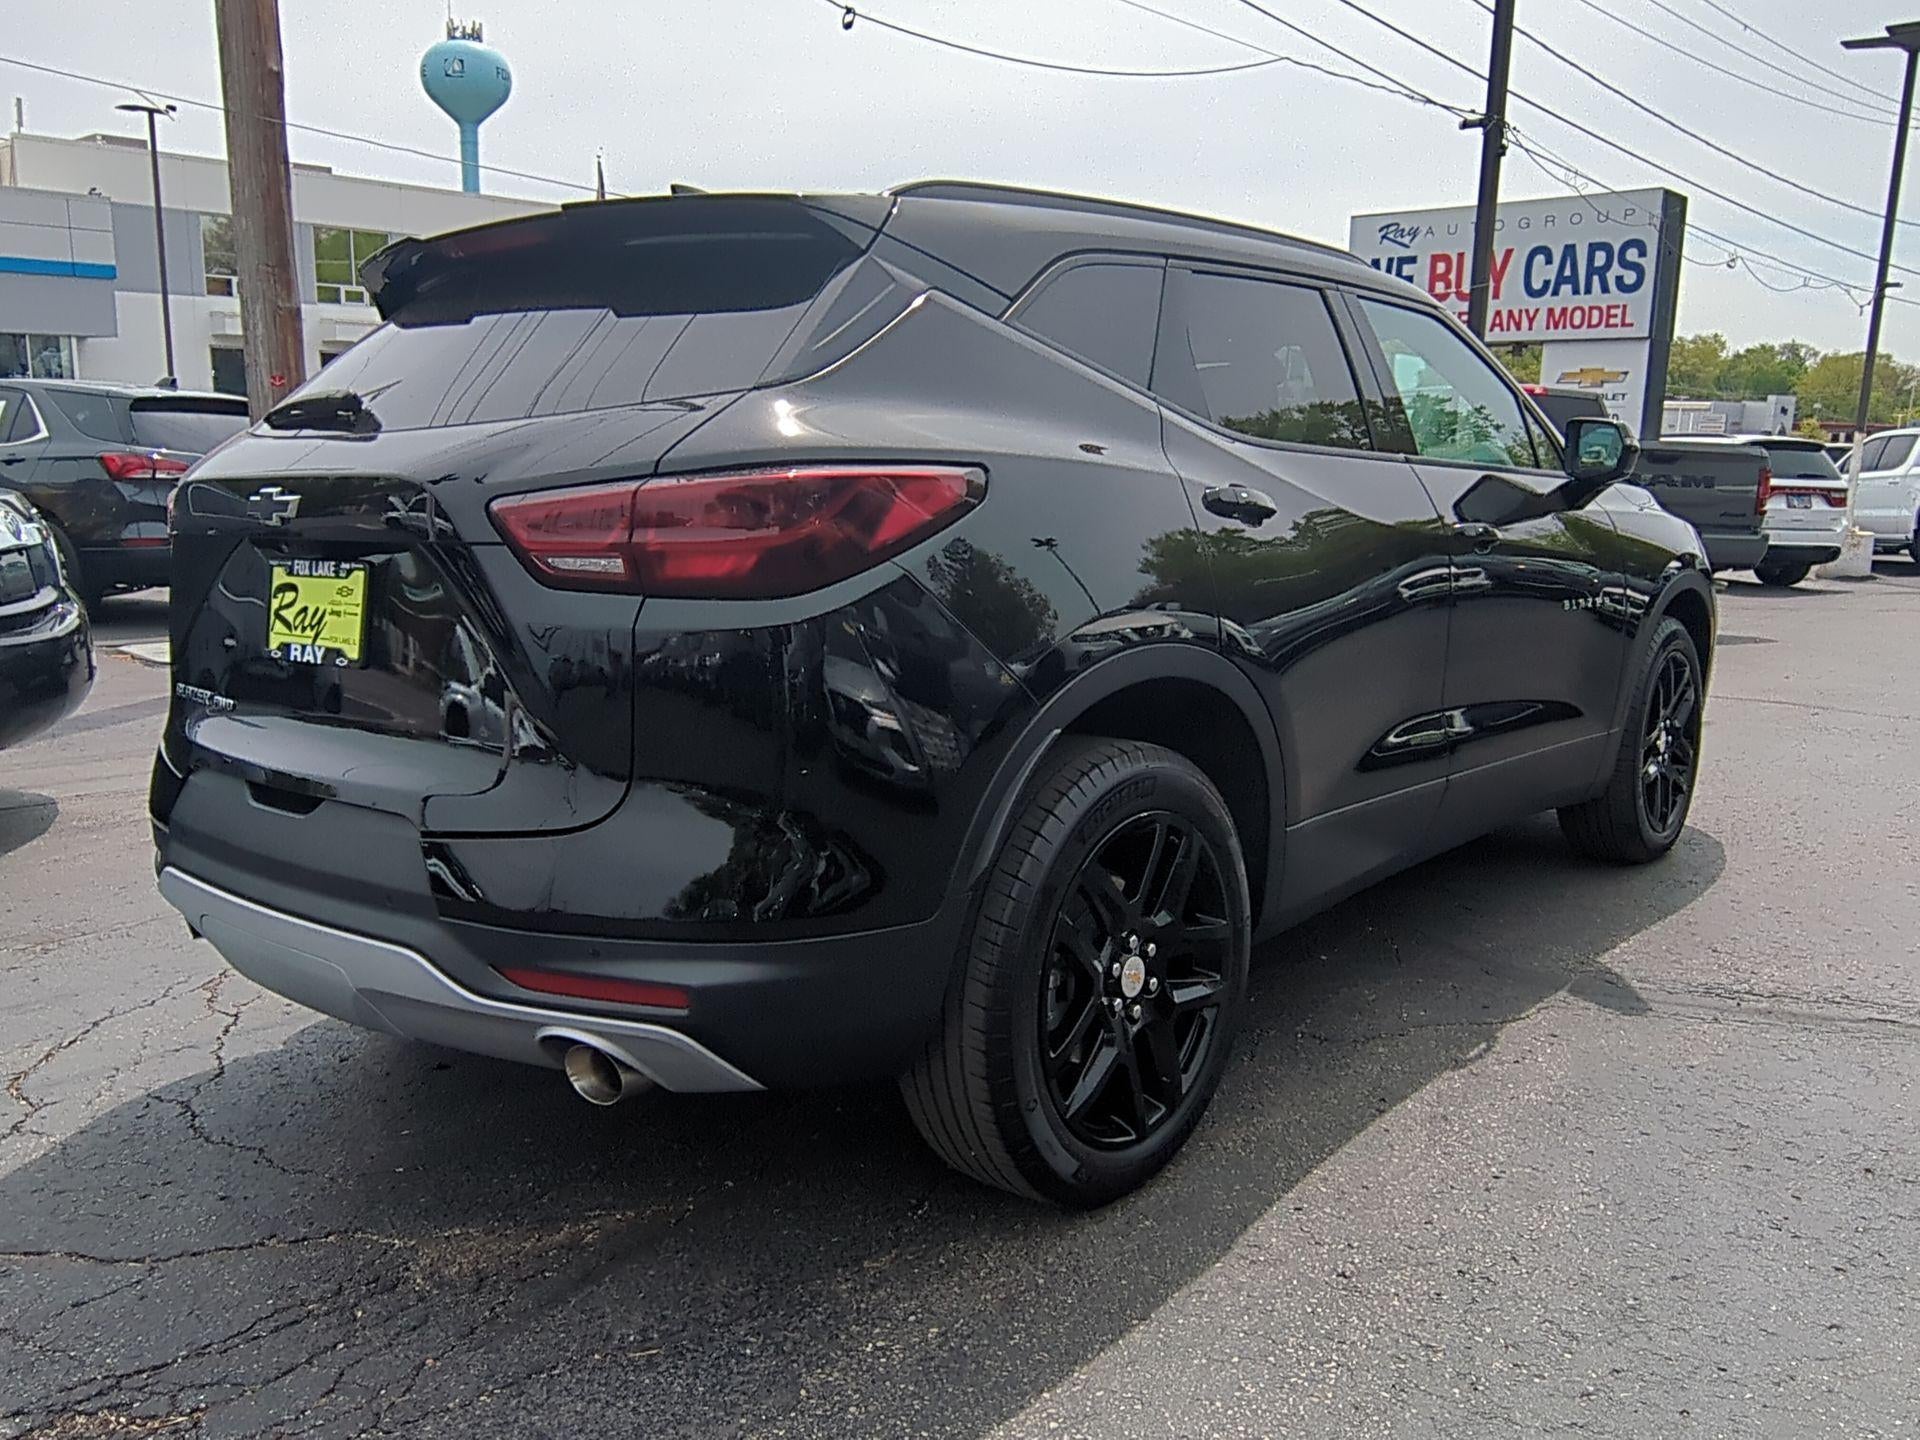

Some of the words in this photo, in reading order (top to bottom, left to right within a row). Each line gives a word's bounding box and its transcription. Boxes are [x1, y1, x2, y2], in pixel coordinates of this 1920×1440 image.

[1378, 222, 1422, 248] Ray
[1523, 238, 1648, 299] CARS
[1489, 308, 1540, 332] ANY
[1545, 304, 1635, 331] MODEL
[294, 560, 309, 576] FOX
[312, 560, 336, 577] LAKE
[271, 582, 328, 645] Ray
[290, 644, 325, 664] RAY
